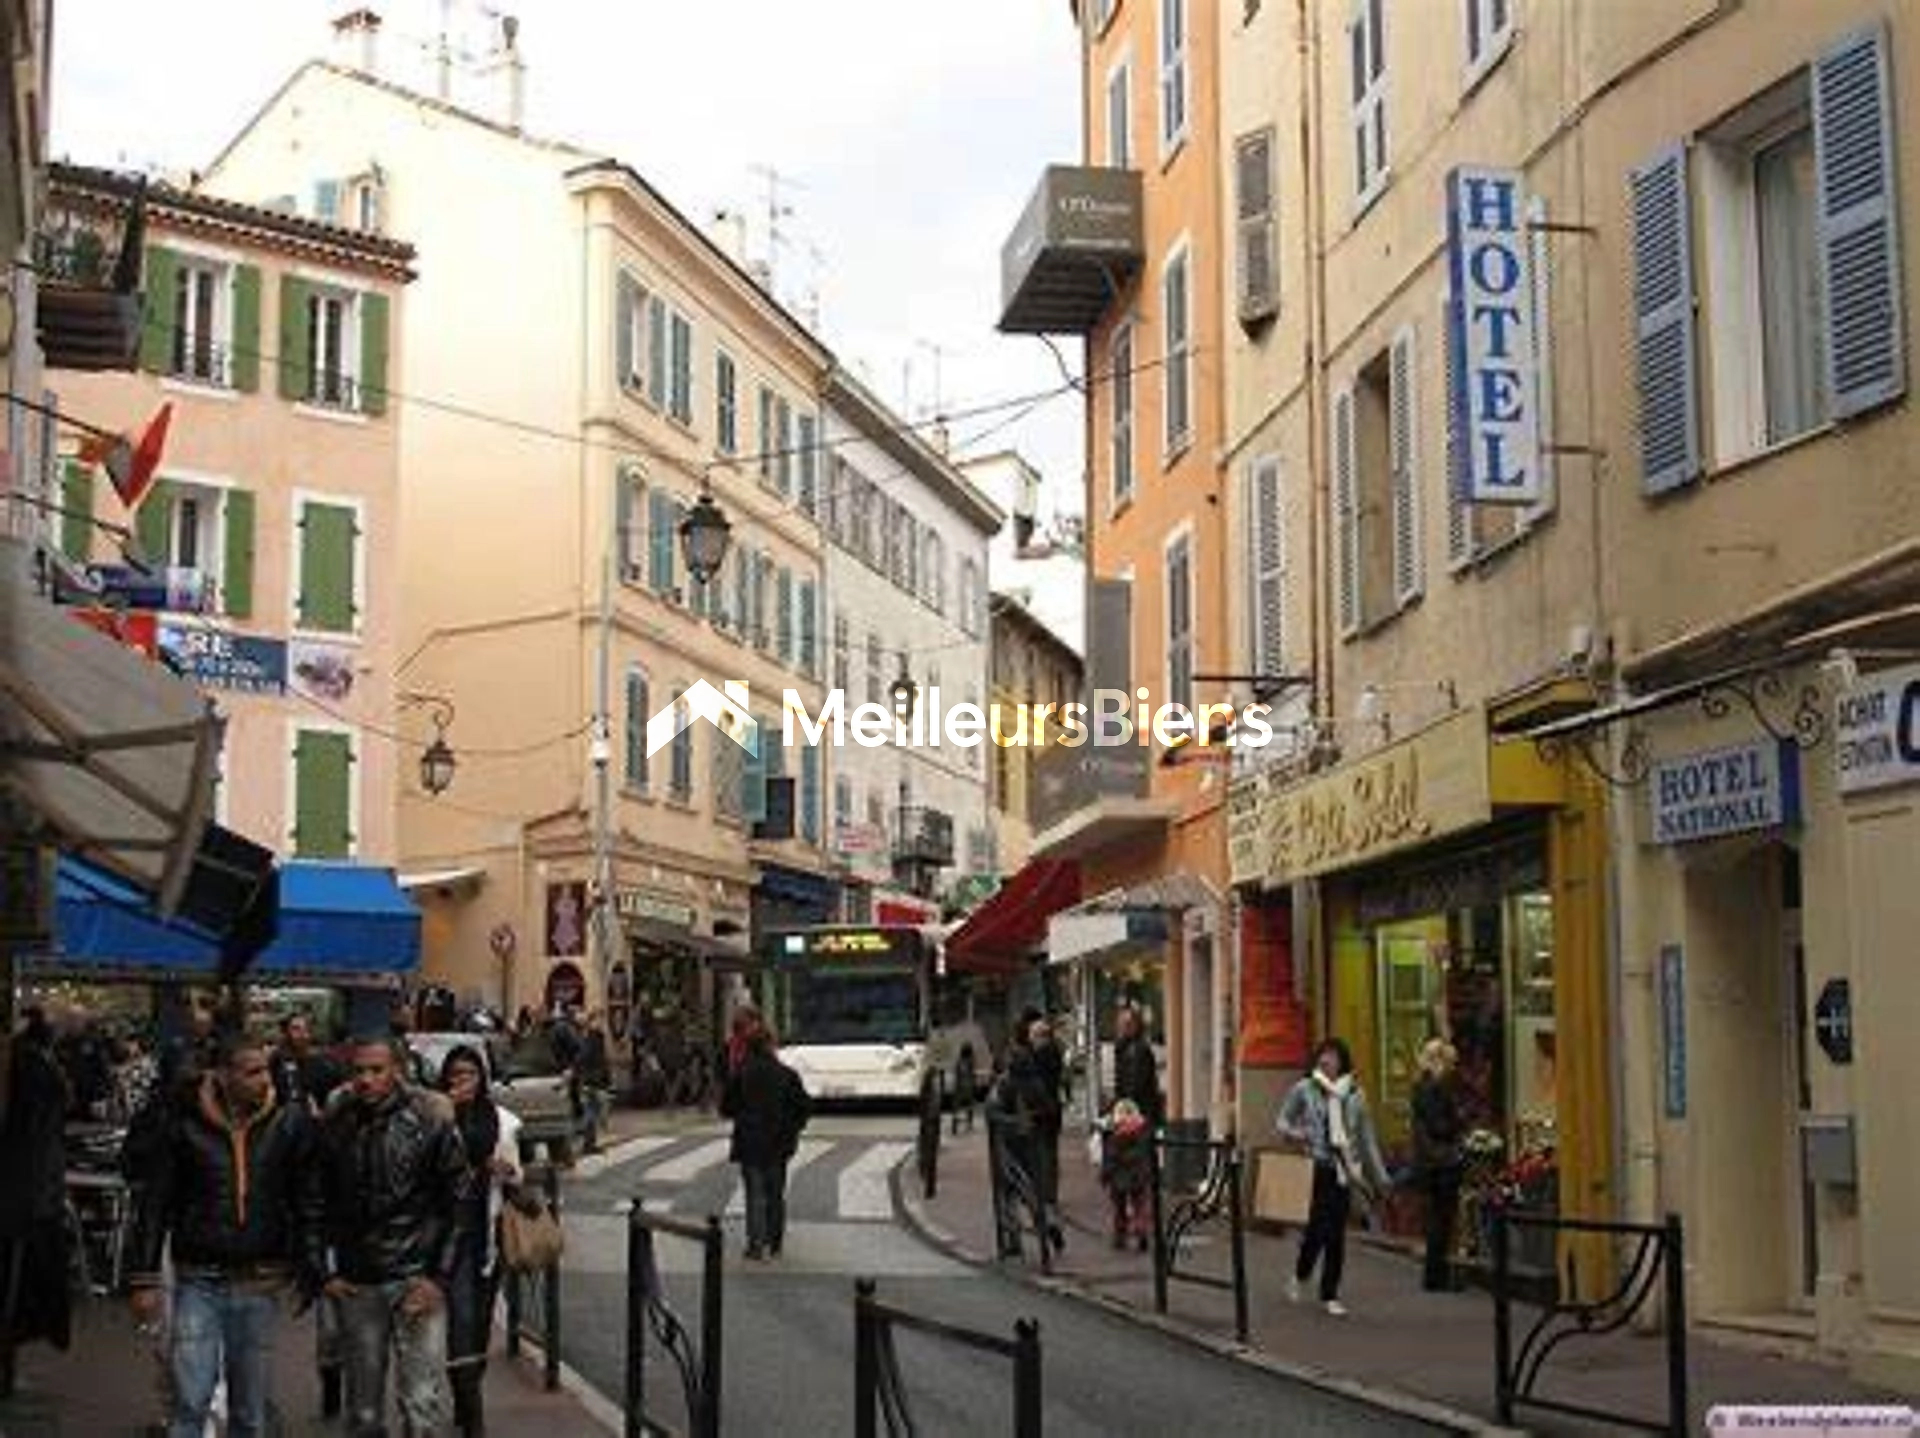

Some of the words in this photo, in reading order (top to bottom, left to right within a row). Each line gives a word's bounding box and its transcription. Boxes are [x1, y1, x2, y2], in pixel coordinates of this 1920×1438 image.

[1464, 178, 1526, 488] HOTEL
[1660, 750, 1768, 806] HOTEL
[1657, 796, 1773, 837] NATIONAL
